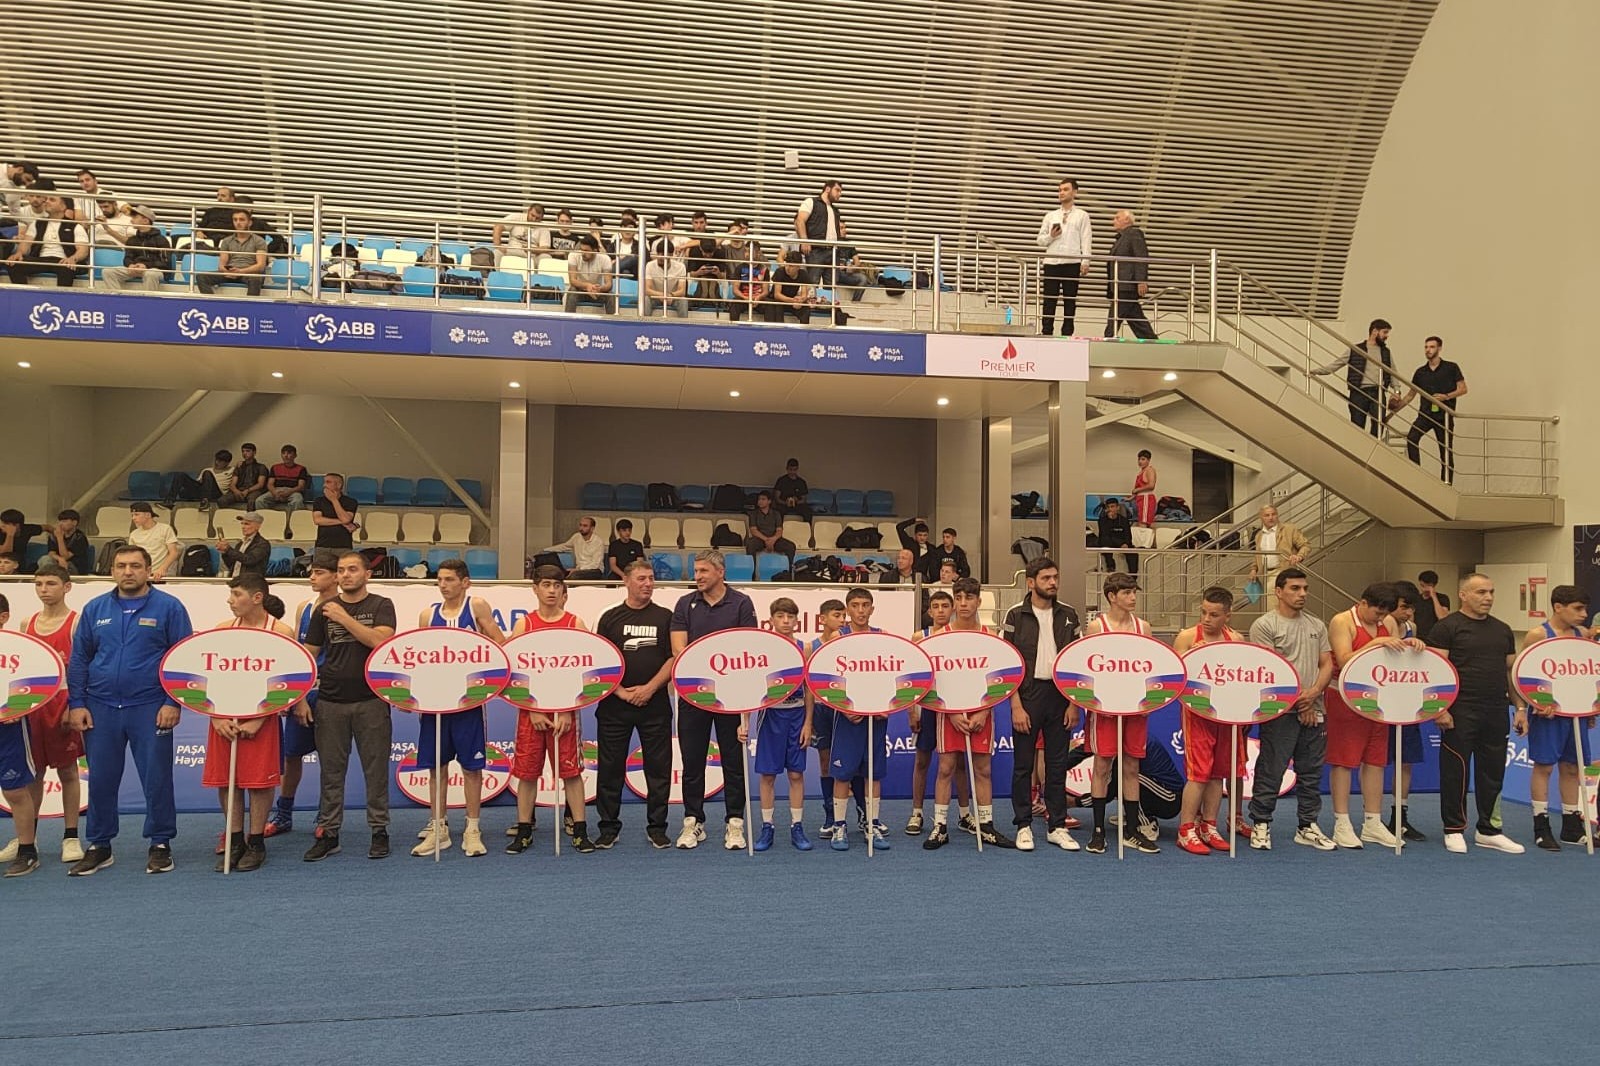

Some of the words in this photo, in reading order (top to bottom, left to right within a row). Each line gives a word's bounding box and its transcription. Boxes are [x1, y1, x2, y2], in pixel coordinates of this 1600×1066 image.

[65, 310, 105, 325] ABB
[212, 316, 250, 331] ABB
[338, 321, 376, 336] ABB
[981, 360, 1035, 372] PREMIER
[623, 625, 657, 637] PUMA
[201, 653, 275, 671] Tərtər
[384, 645, 490, 669] Ağcabədi
[517, 652, 593, 673] Siyəzən
[709, 651, 769, 675] Quba
[836, 654, 905, 676] Şəmkir
[931, 654, 989, 672] Tovuz
[1087, 654, 1153, 673] Gəncə
[1197, 662, 1275, 686] Ağstafa
[1371, 664, 1430, 686] Qazax
[176, 745, 206, 755] PAŞA
[175, 756, 206, 767] Həya
